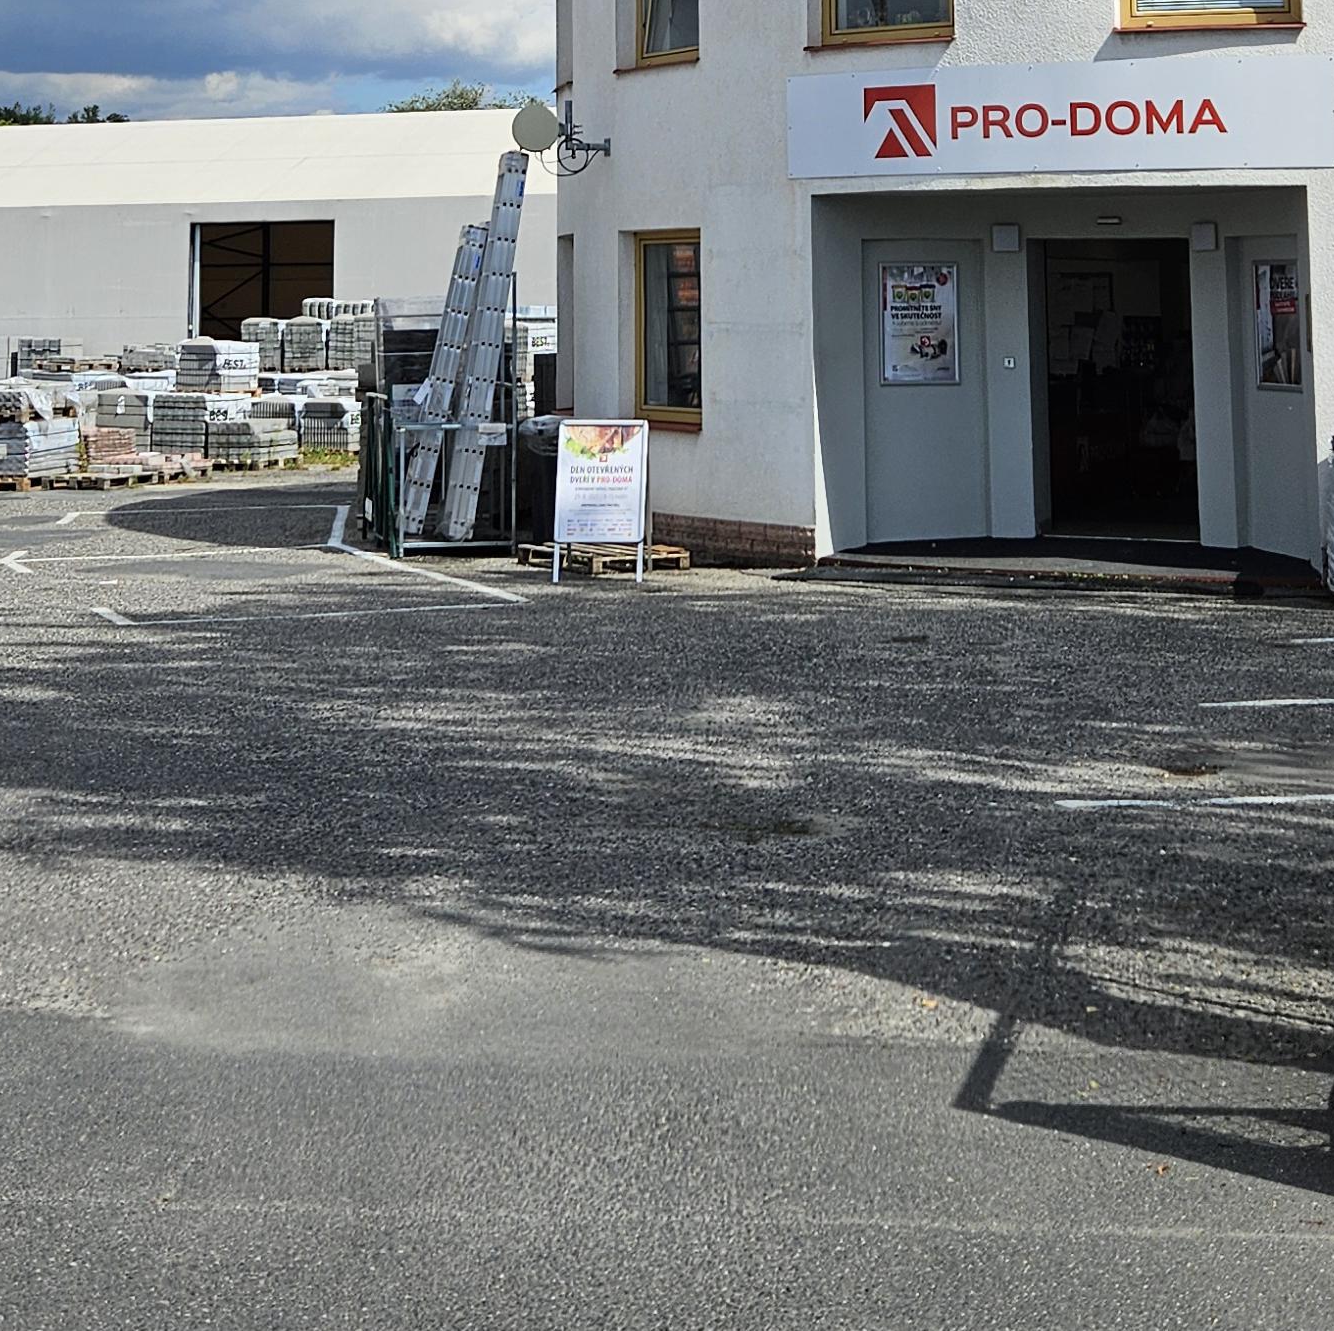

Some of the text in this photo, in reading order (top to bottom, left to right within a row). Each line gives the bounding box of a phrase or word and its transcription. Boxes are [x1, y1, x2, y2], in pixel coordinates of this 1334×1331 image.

[950, 98, 1229, 140] PRO-DOMA
[570, 464, 634, 474] DEN OTEVŘENÝCH
